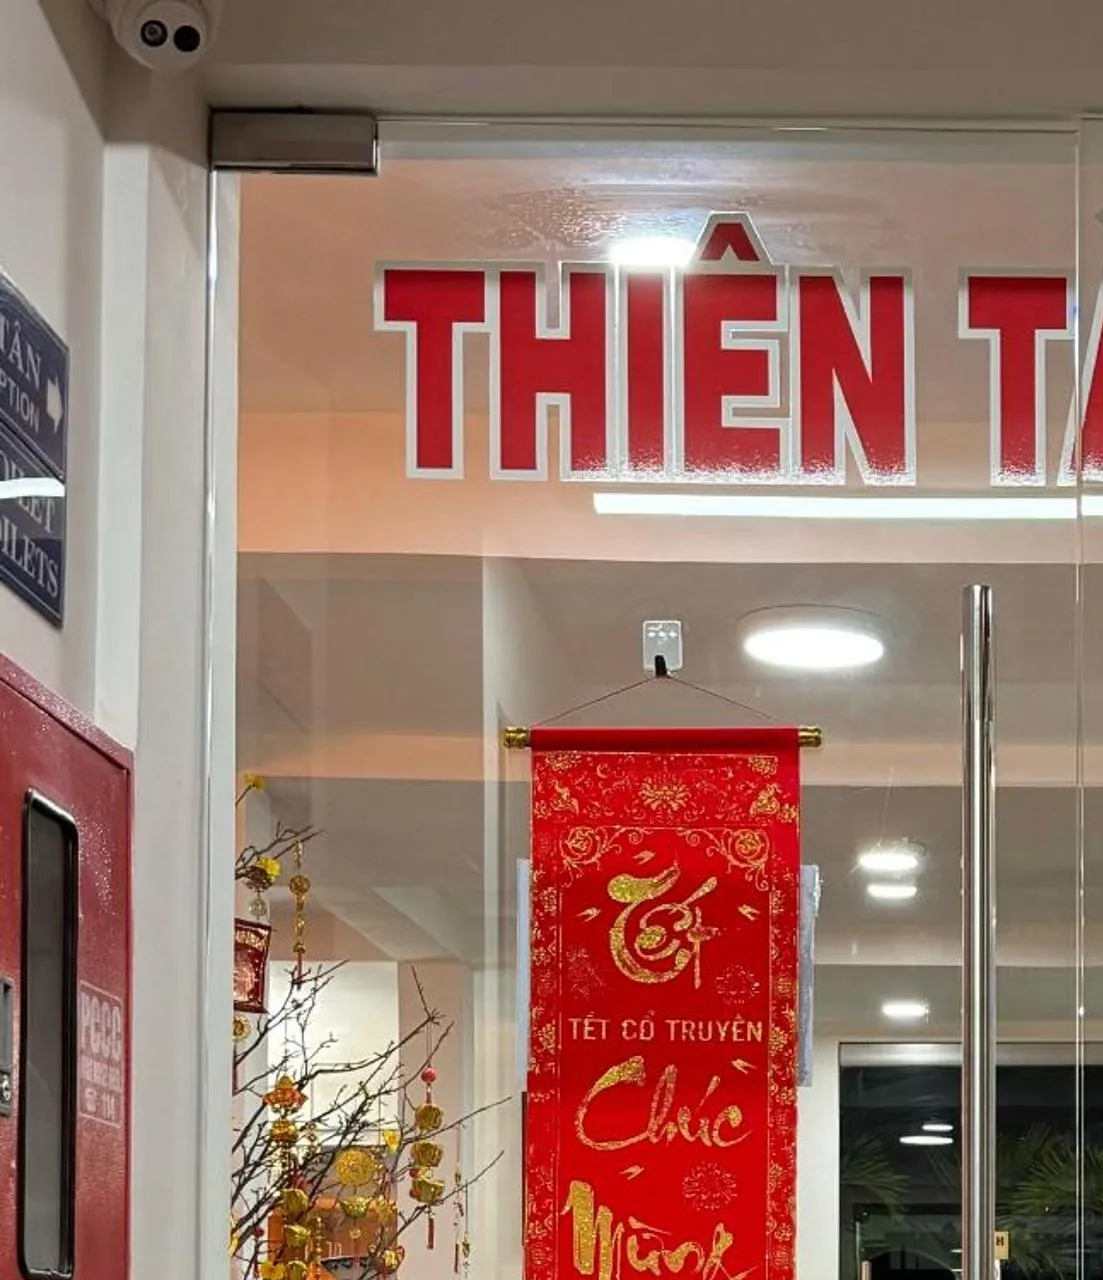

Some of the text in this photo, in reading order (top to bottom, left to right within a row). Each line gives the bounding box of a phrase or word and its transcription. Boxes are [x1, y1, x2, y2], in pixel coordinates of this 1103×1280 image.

[375, 211, 917, 487] THIÊN
[568, 1011, 610, 1040] TẾT
[621, 1010, 656, 1040] CỔ
[574, 1056, 751, 1150] Chúc
